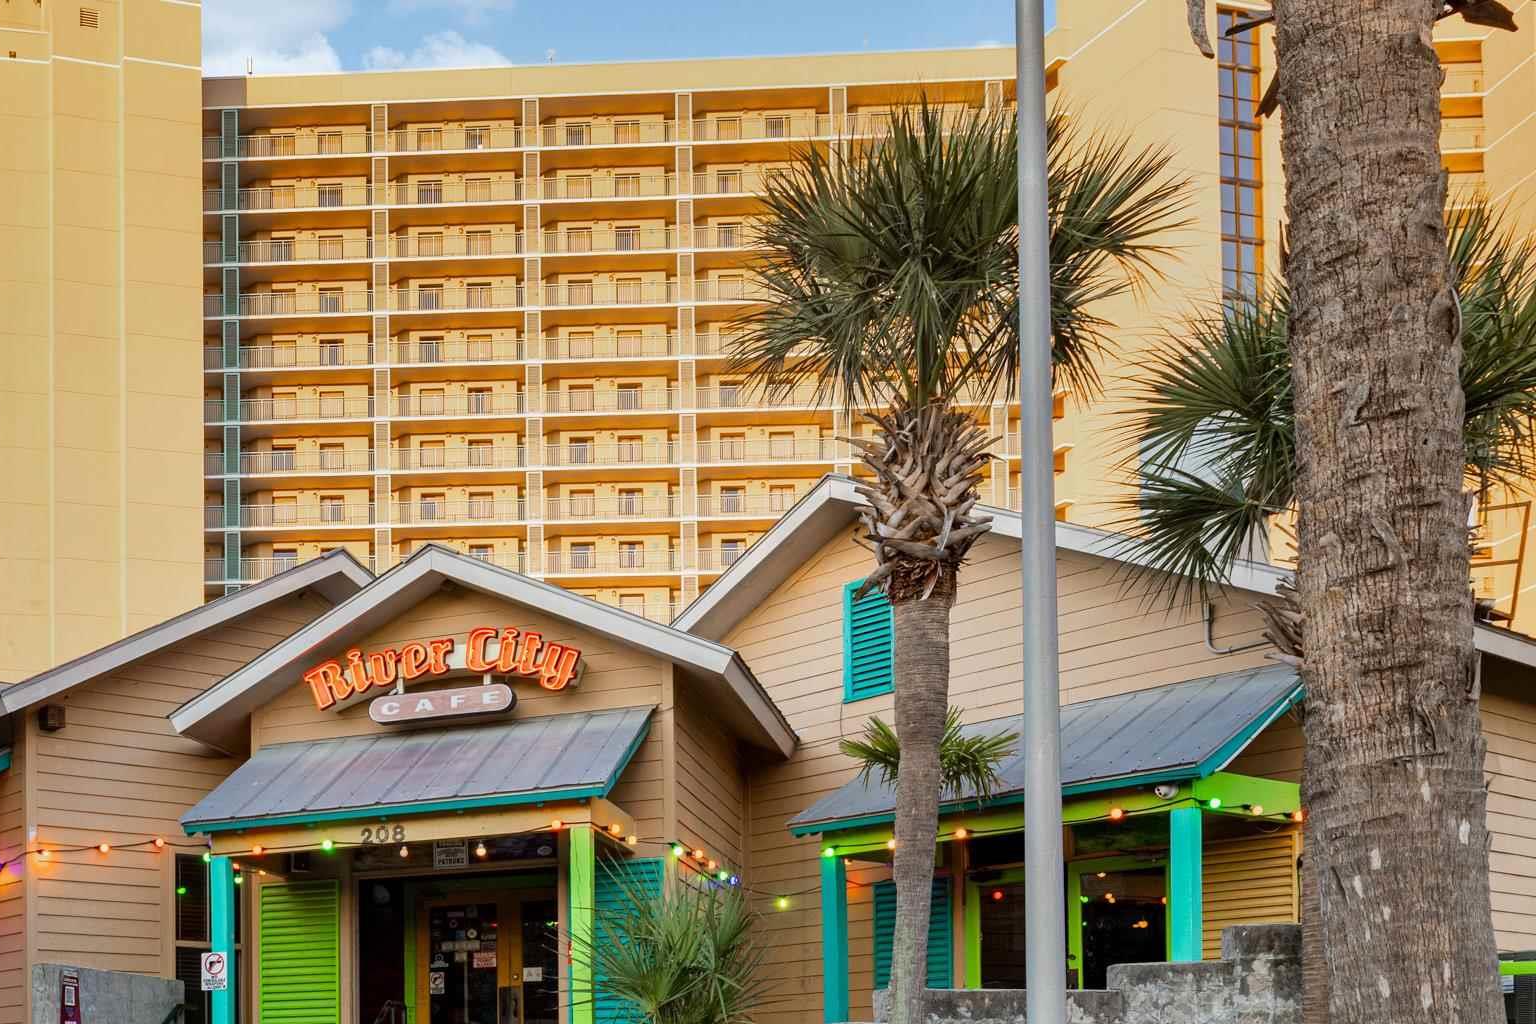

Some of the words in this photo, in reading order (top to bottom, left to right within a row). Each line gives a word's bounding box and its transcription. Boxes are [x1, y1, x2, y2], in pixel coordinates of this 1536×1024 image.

[304, 637, 455, 711] River
[466, 627, 581, 691] City
[380, 690, 501, 716] CAFE
[360, 824, 406, 845] 208
